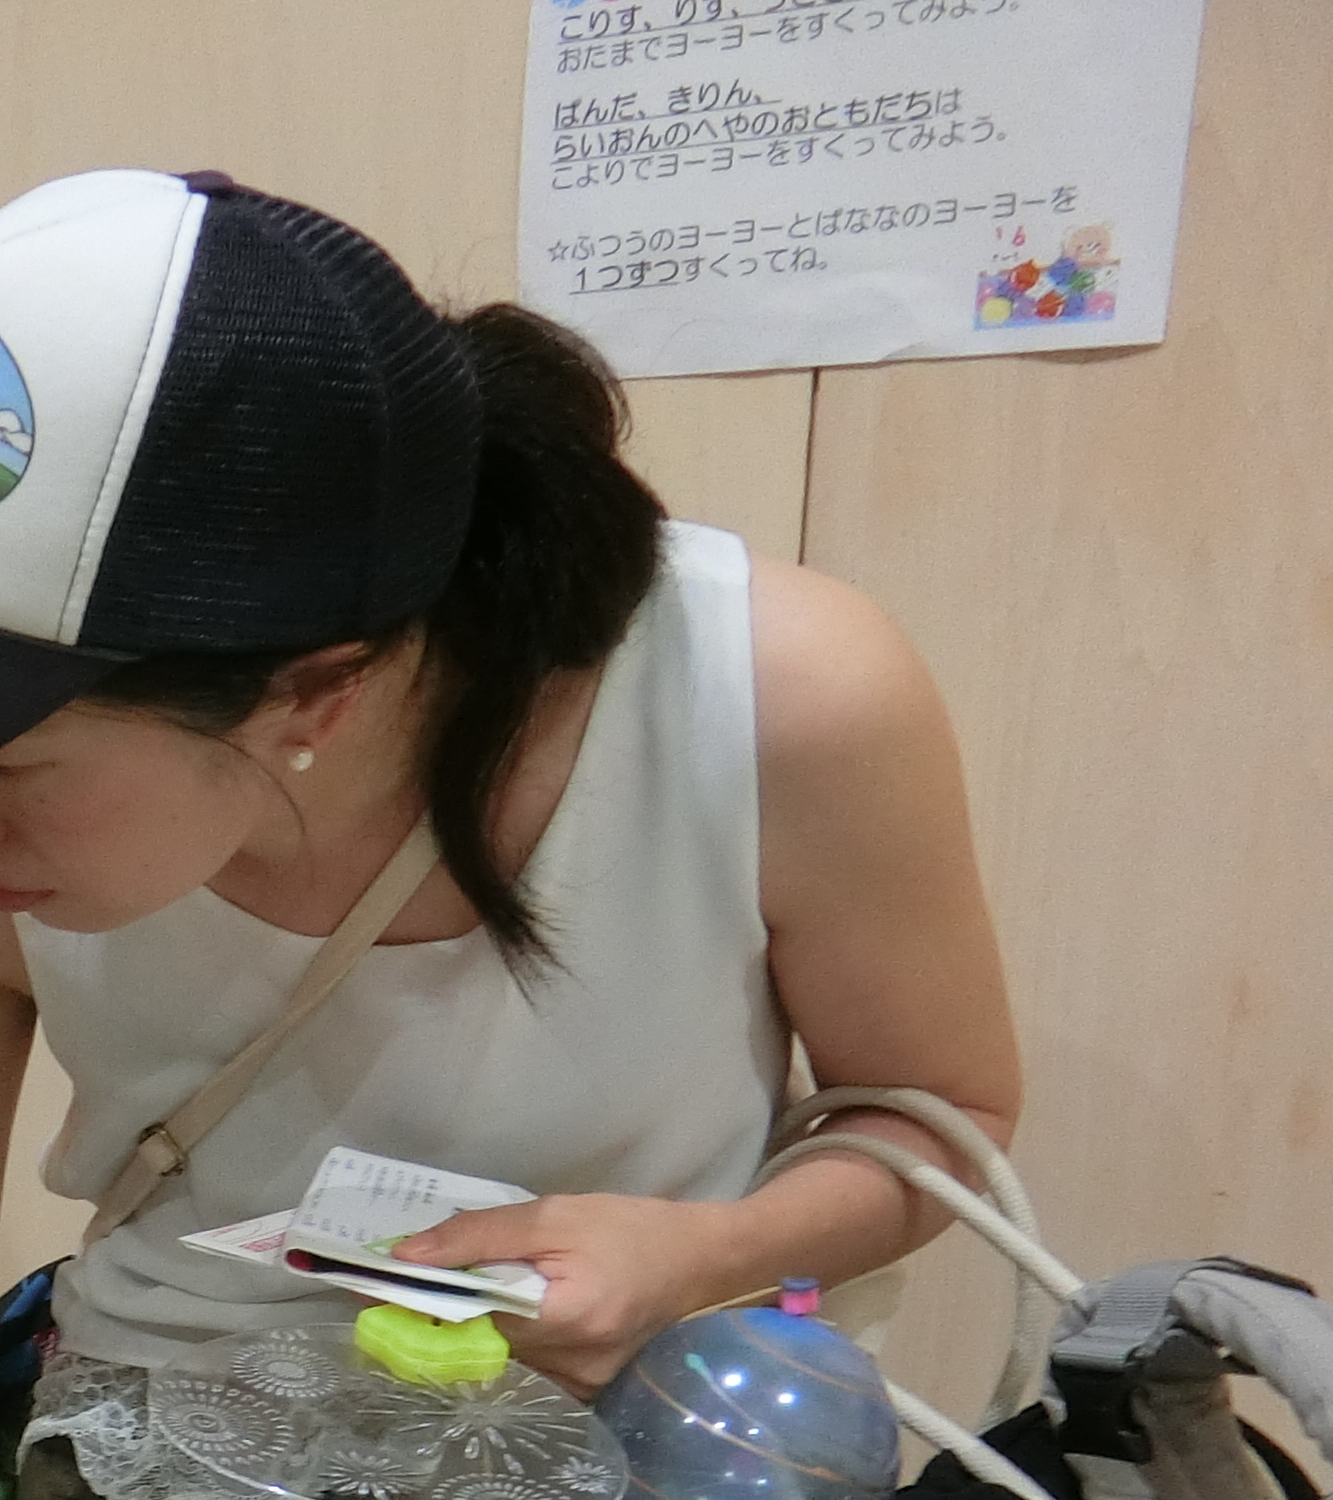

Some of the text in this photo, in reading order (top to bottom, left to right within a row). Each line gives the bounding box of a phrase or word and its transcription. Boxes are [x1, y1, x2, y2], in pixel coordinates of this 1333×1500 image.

[551, 114, 1007, 190] こよりでヨーヨーをすくってみよう。
[552, 87, 963, 160] らいおんのへやのおともだちは
